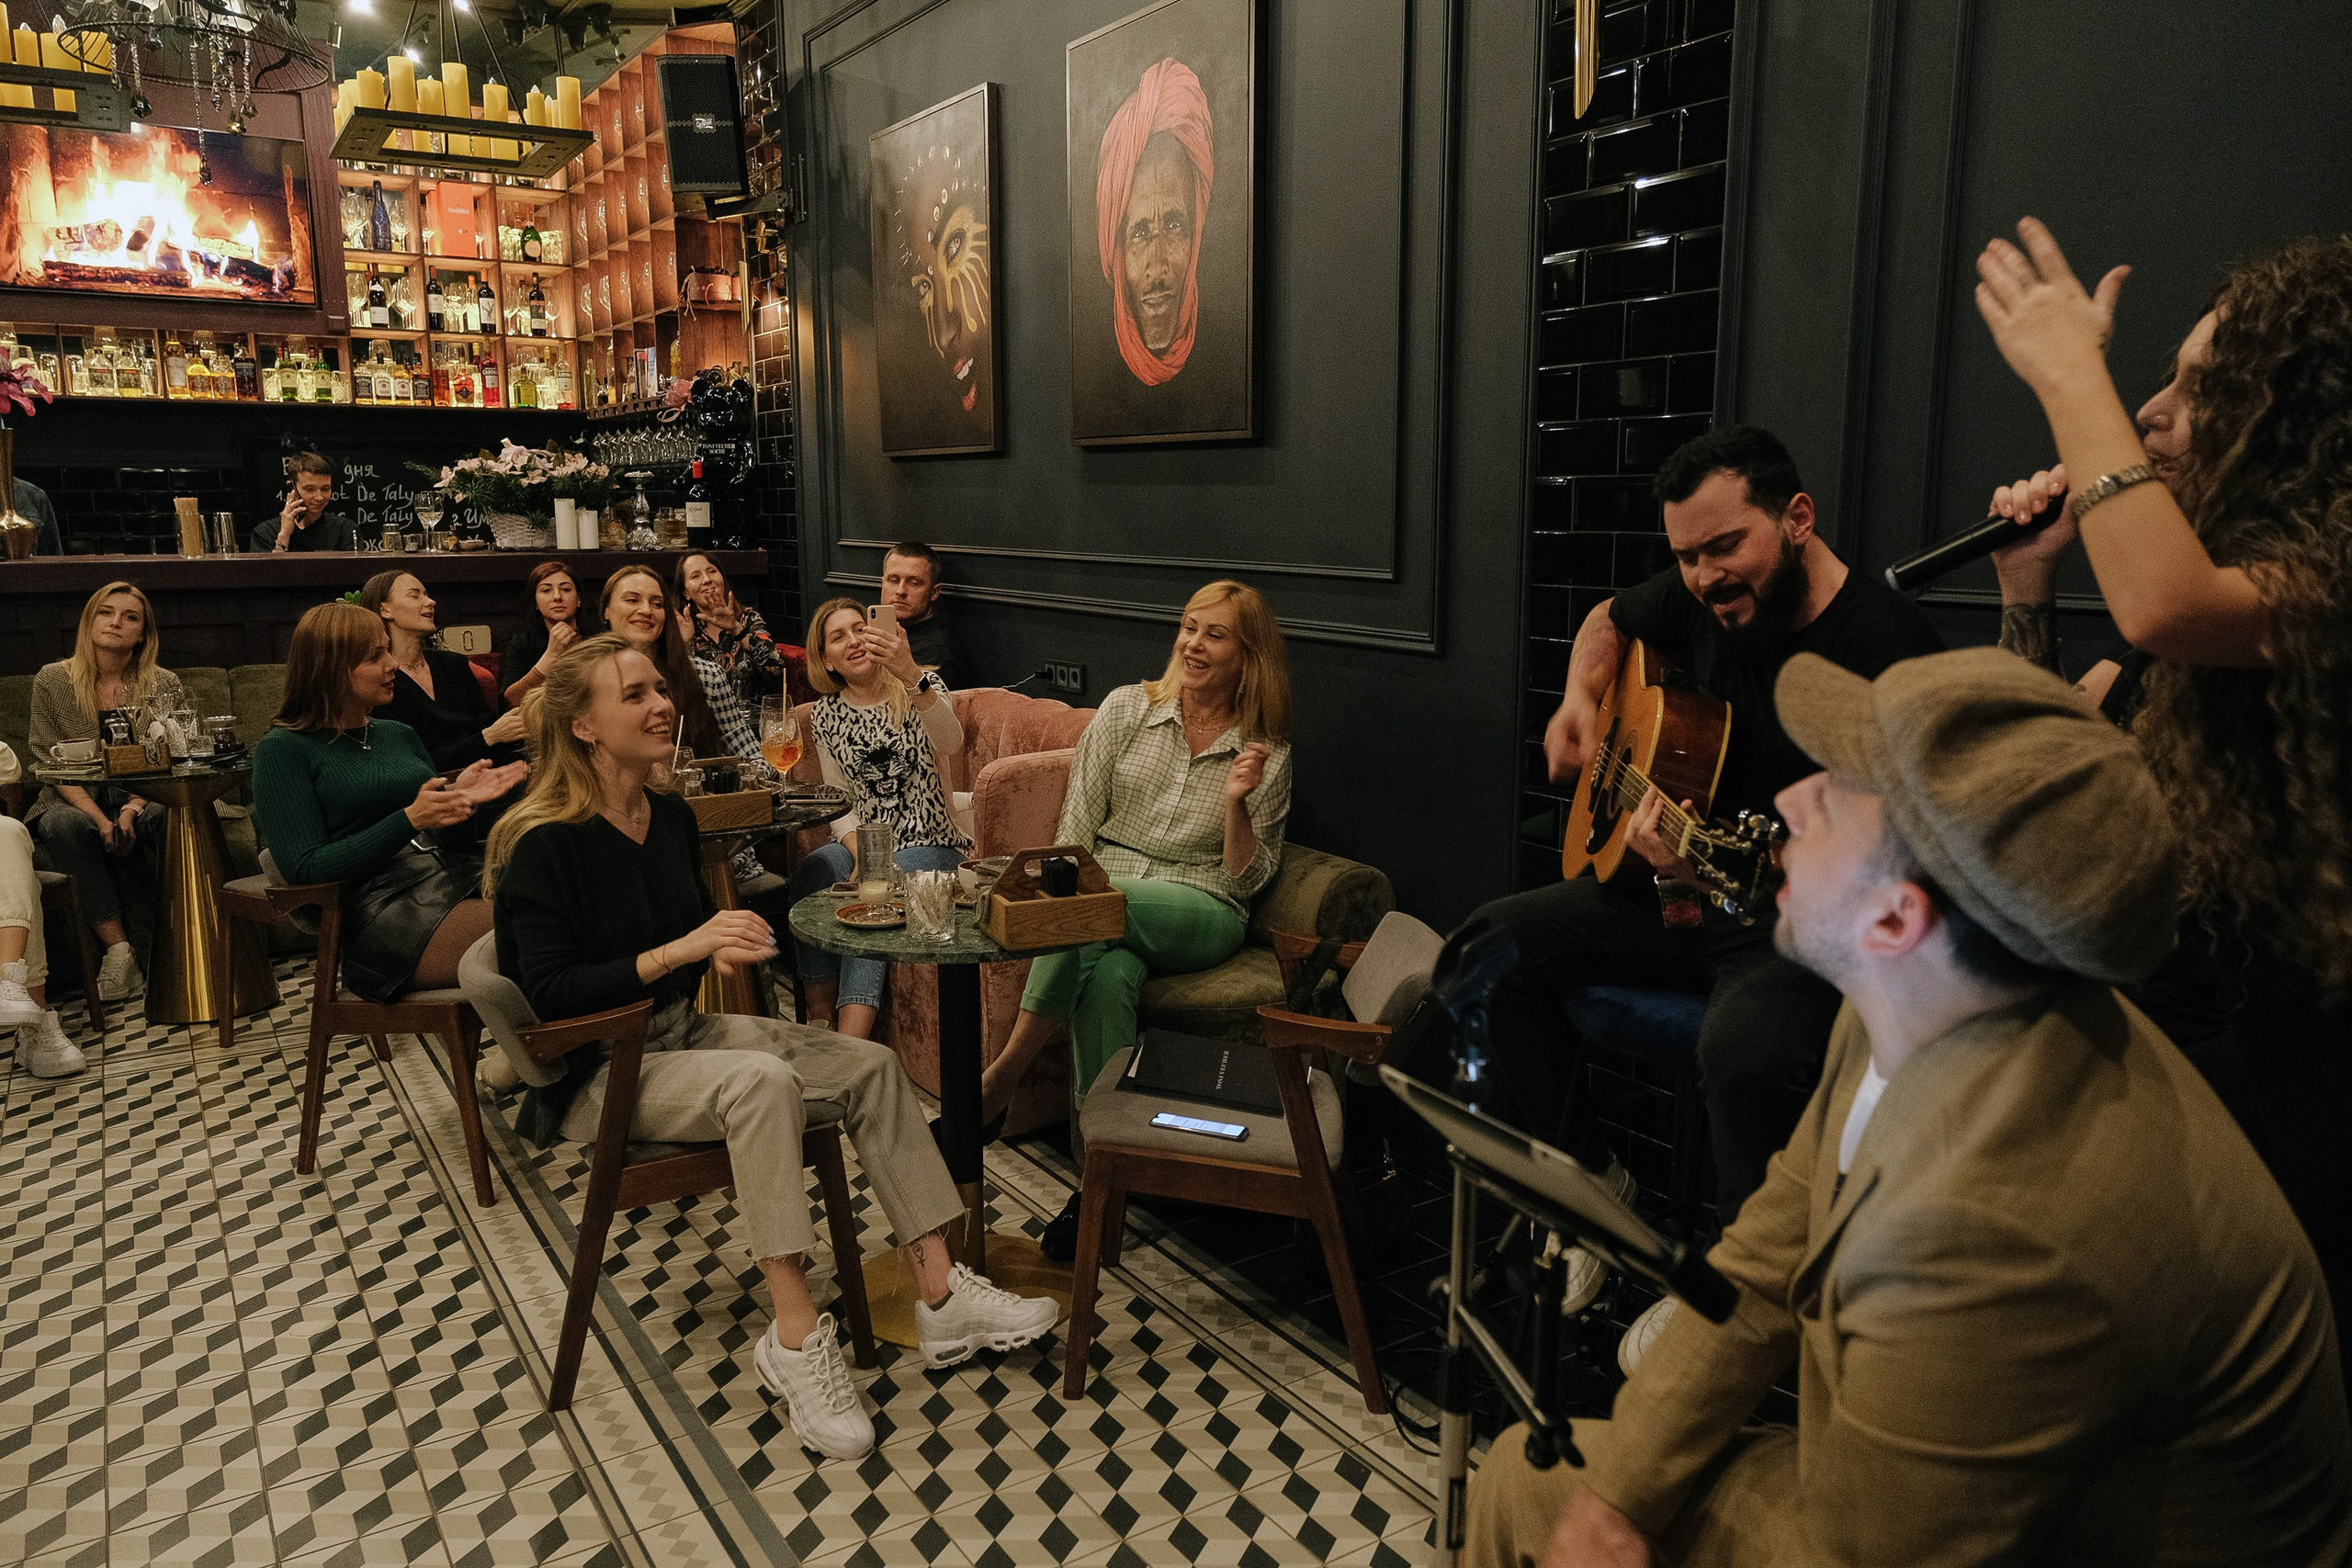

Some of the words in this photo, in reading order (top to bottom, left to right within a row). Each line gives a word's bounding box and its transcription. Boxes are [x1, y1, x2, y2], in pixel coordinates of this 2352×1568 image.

[357, 482, 377, 502] De
[357, 506, 378, 525] De
[1216, 1075, 1224, 1090] TONI
